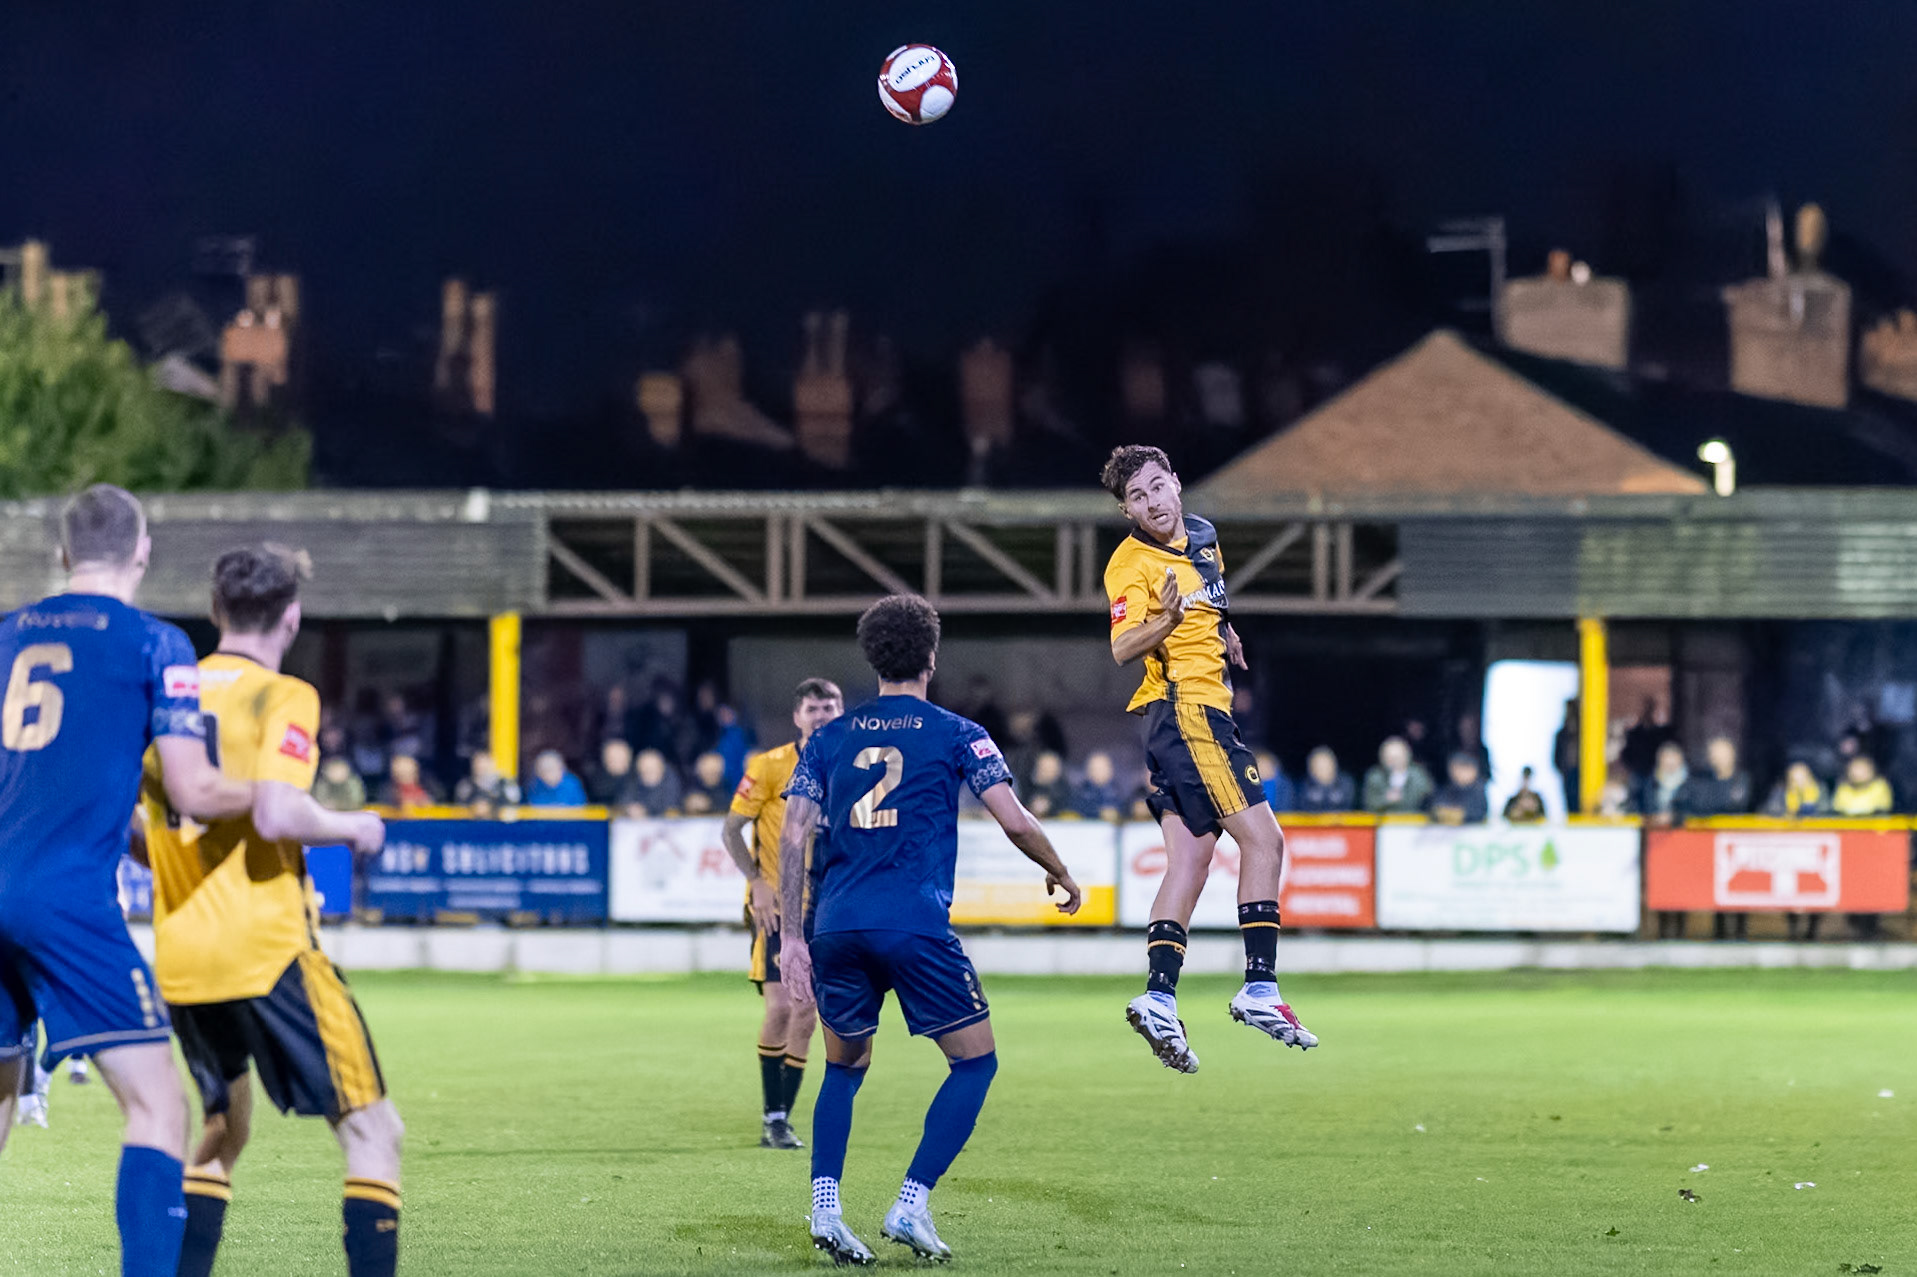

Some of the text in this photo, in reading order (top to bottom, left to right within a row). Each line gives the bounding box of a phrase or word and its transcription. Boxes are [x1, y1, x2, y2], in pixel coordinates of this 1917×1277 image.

[2, 642, 73, 752] 6
[852, 714, 923, 730] Novelis
[850, 746, 903, 829] 2
[1453, 841, 1531, 877] DPS
